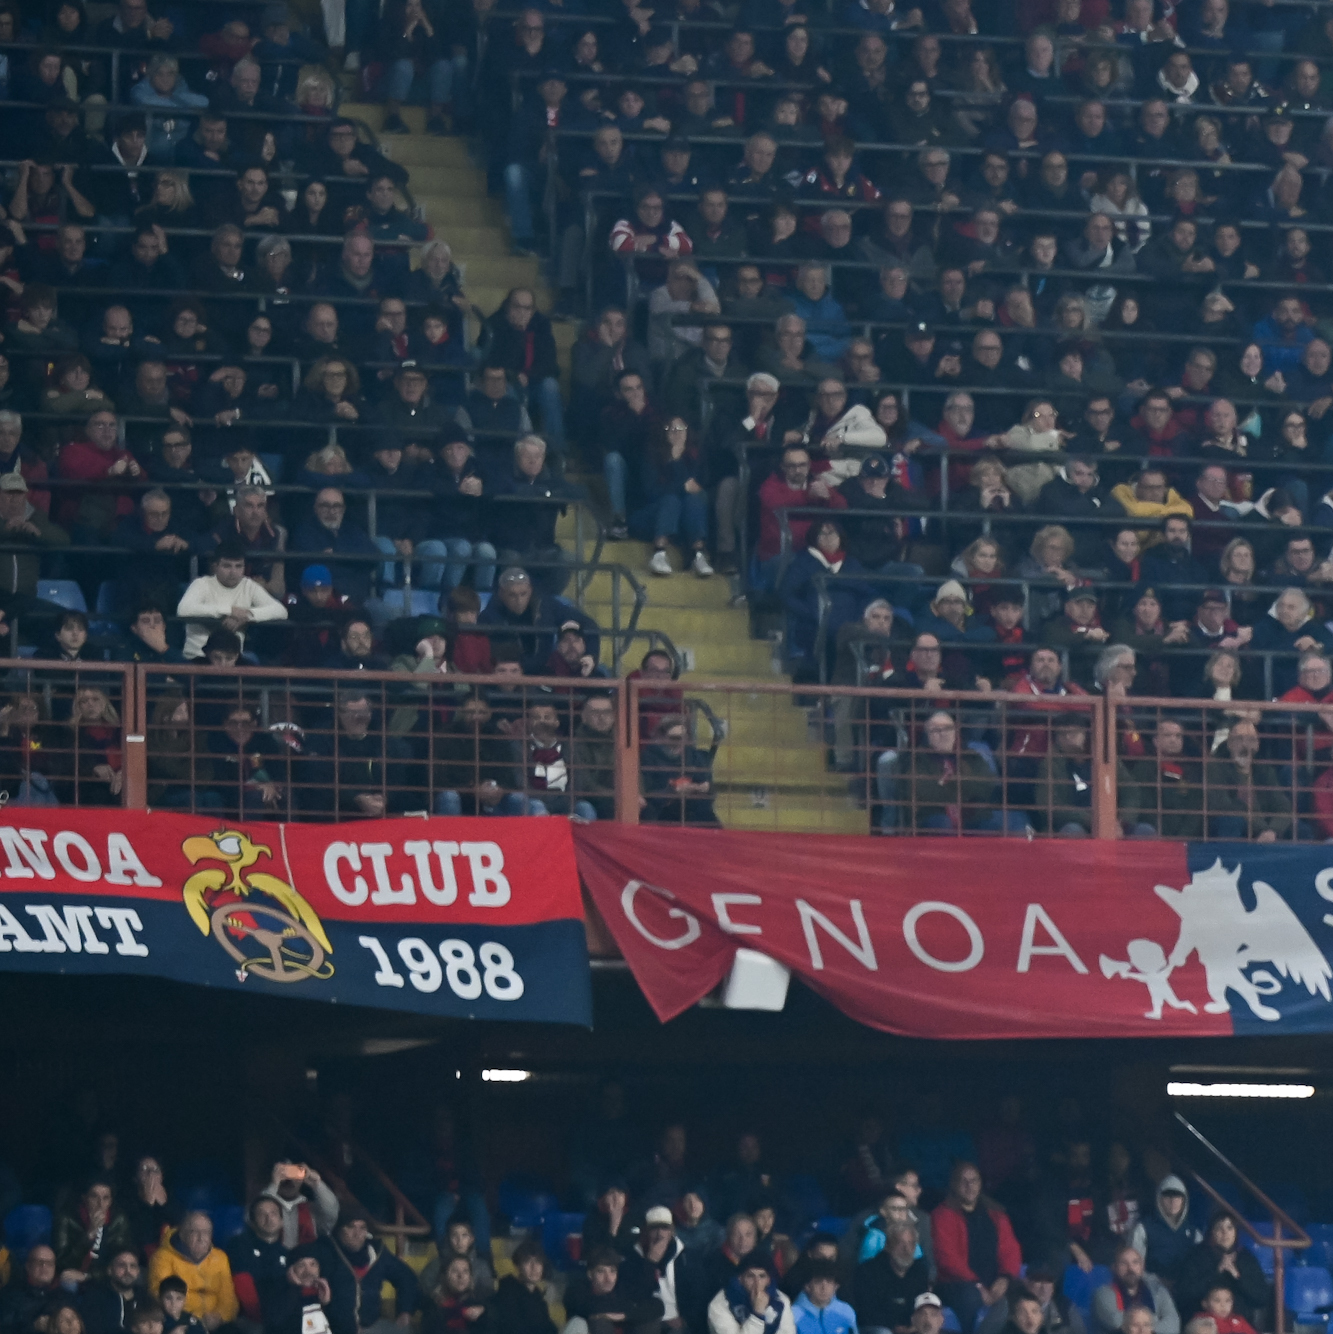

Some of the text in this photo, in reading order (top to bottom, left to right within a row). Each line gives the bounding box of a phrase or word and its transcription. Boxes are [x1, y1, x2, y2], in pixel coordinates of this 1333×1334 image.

[323, 840, 512, 907] CLUB
[621, 880, 1089, 973] GENOA
[359, 935, 524, 1001] 1988
